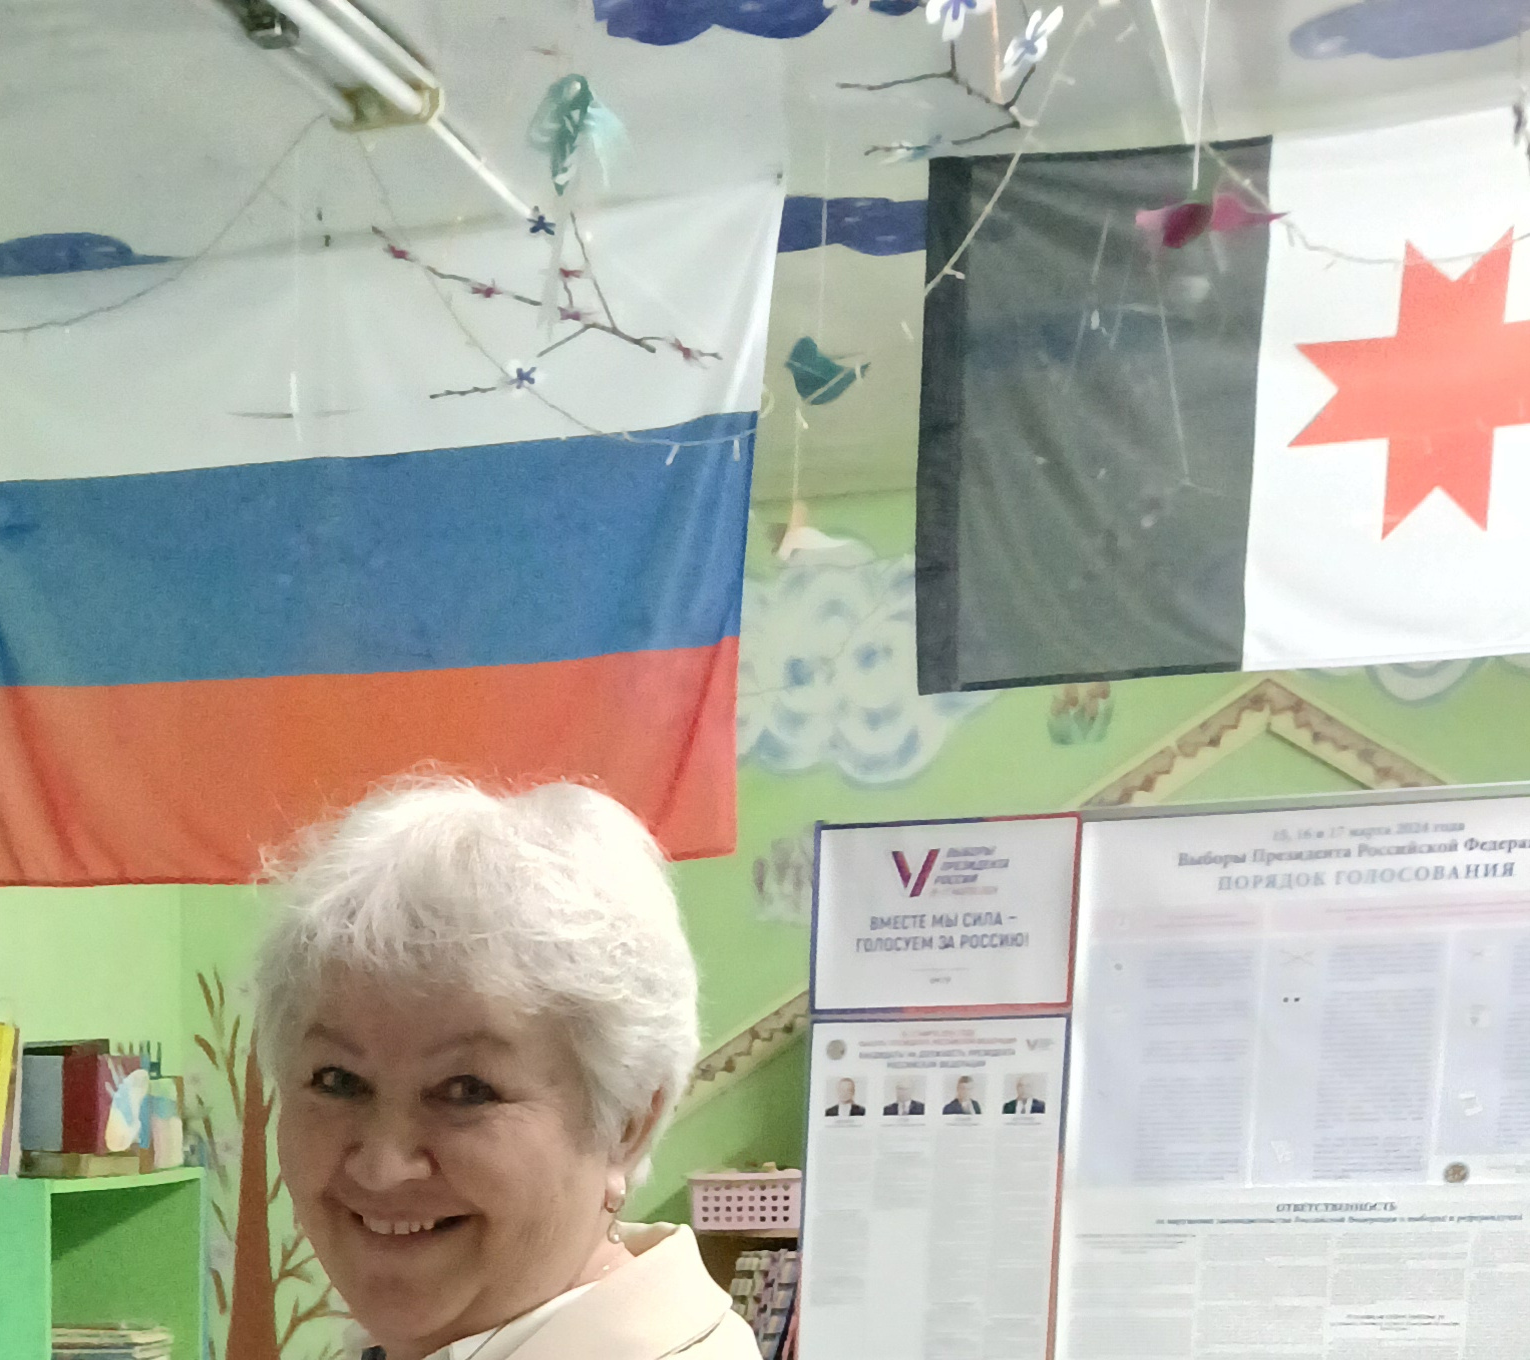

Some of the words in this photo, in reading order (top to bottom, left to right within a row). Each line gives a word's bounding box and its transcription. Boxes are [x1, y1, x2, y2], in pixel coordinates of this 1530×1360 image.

[1178, 851, 1246, 868] Выборы
[1252, 848, 1351, 866] Президента
[1358, 839, 1458, 857] Российской
[1463, 837, 1530, 853] Федера
[1218, 870, 1327, 891] ПОРЯДОК
[1335, 862, 1516, 886] ГОЛОСОВАНИЯ
[870, 914, 927, 931] ВМЕСТЕ
[931, 912, 959, 928] МЫ
[962, 911, 1003, 927] СИЛА
[856, 936, 933, 952] ГОЛОСУЕМ
[938, 935, 955, 950] ЗА
[960, 932, 1030, 949] РОССИЮ!
